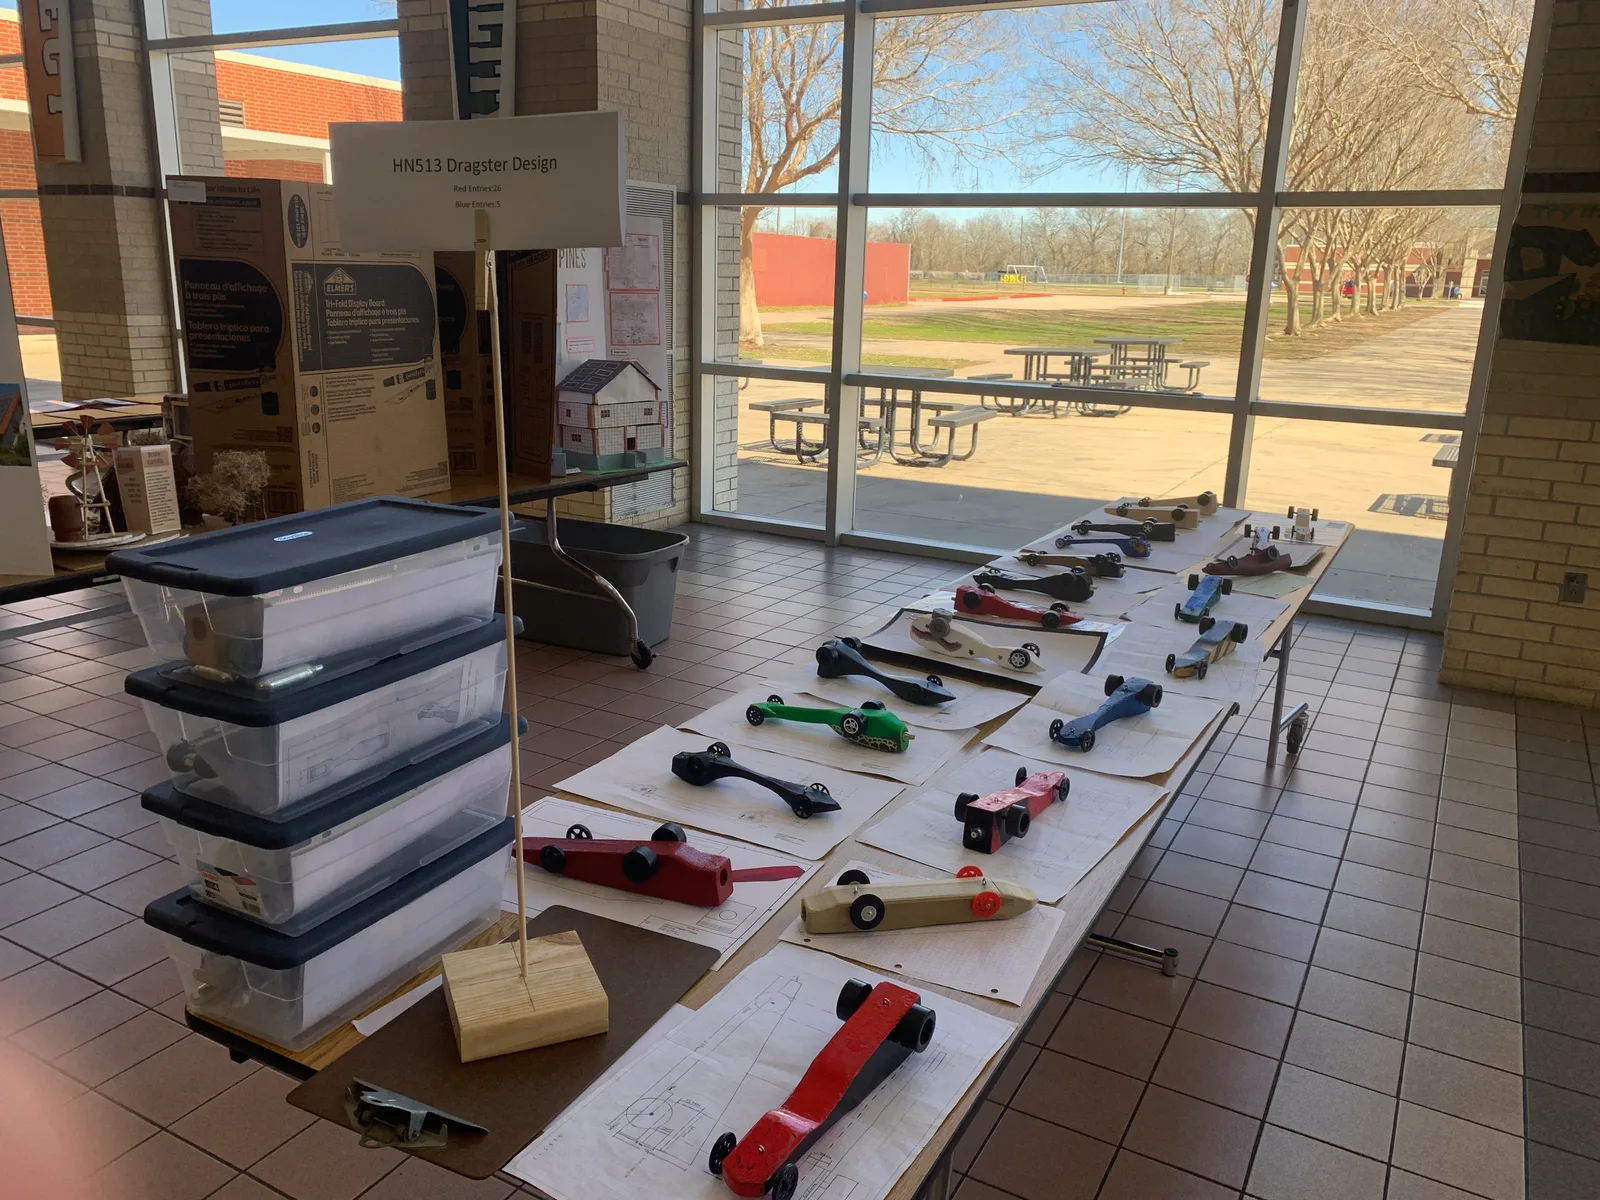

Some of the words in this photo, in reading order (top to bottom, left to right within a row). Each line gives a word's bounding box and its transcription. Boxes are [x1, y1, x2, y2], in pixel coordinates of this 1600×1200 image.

[393, 158, 442, 173] HN513
[447, 158, 508, 175] Dragster
[512, 156, 558, 173] Design
[453, 185, 467, 193] Red
[468, 184, 502, 193] Entries:26
[455, 200, 471, 208] Blue
[472, 200, 501, 209] Entries:5
[559, 248, 586, 268] PINES
[326, 284, 354, 292] ELMER'S
[325, 299, 347, 307] Tri-Fold
[369, 299, 385, 307] Board
